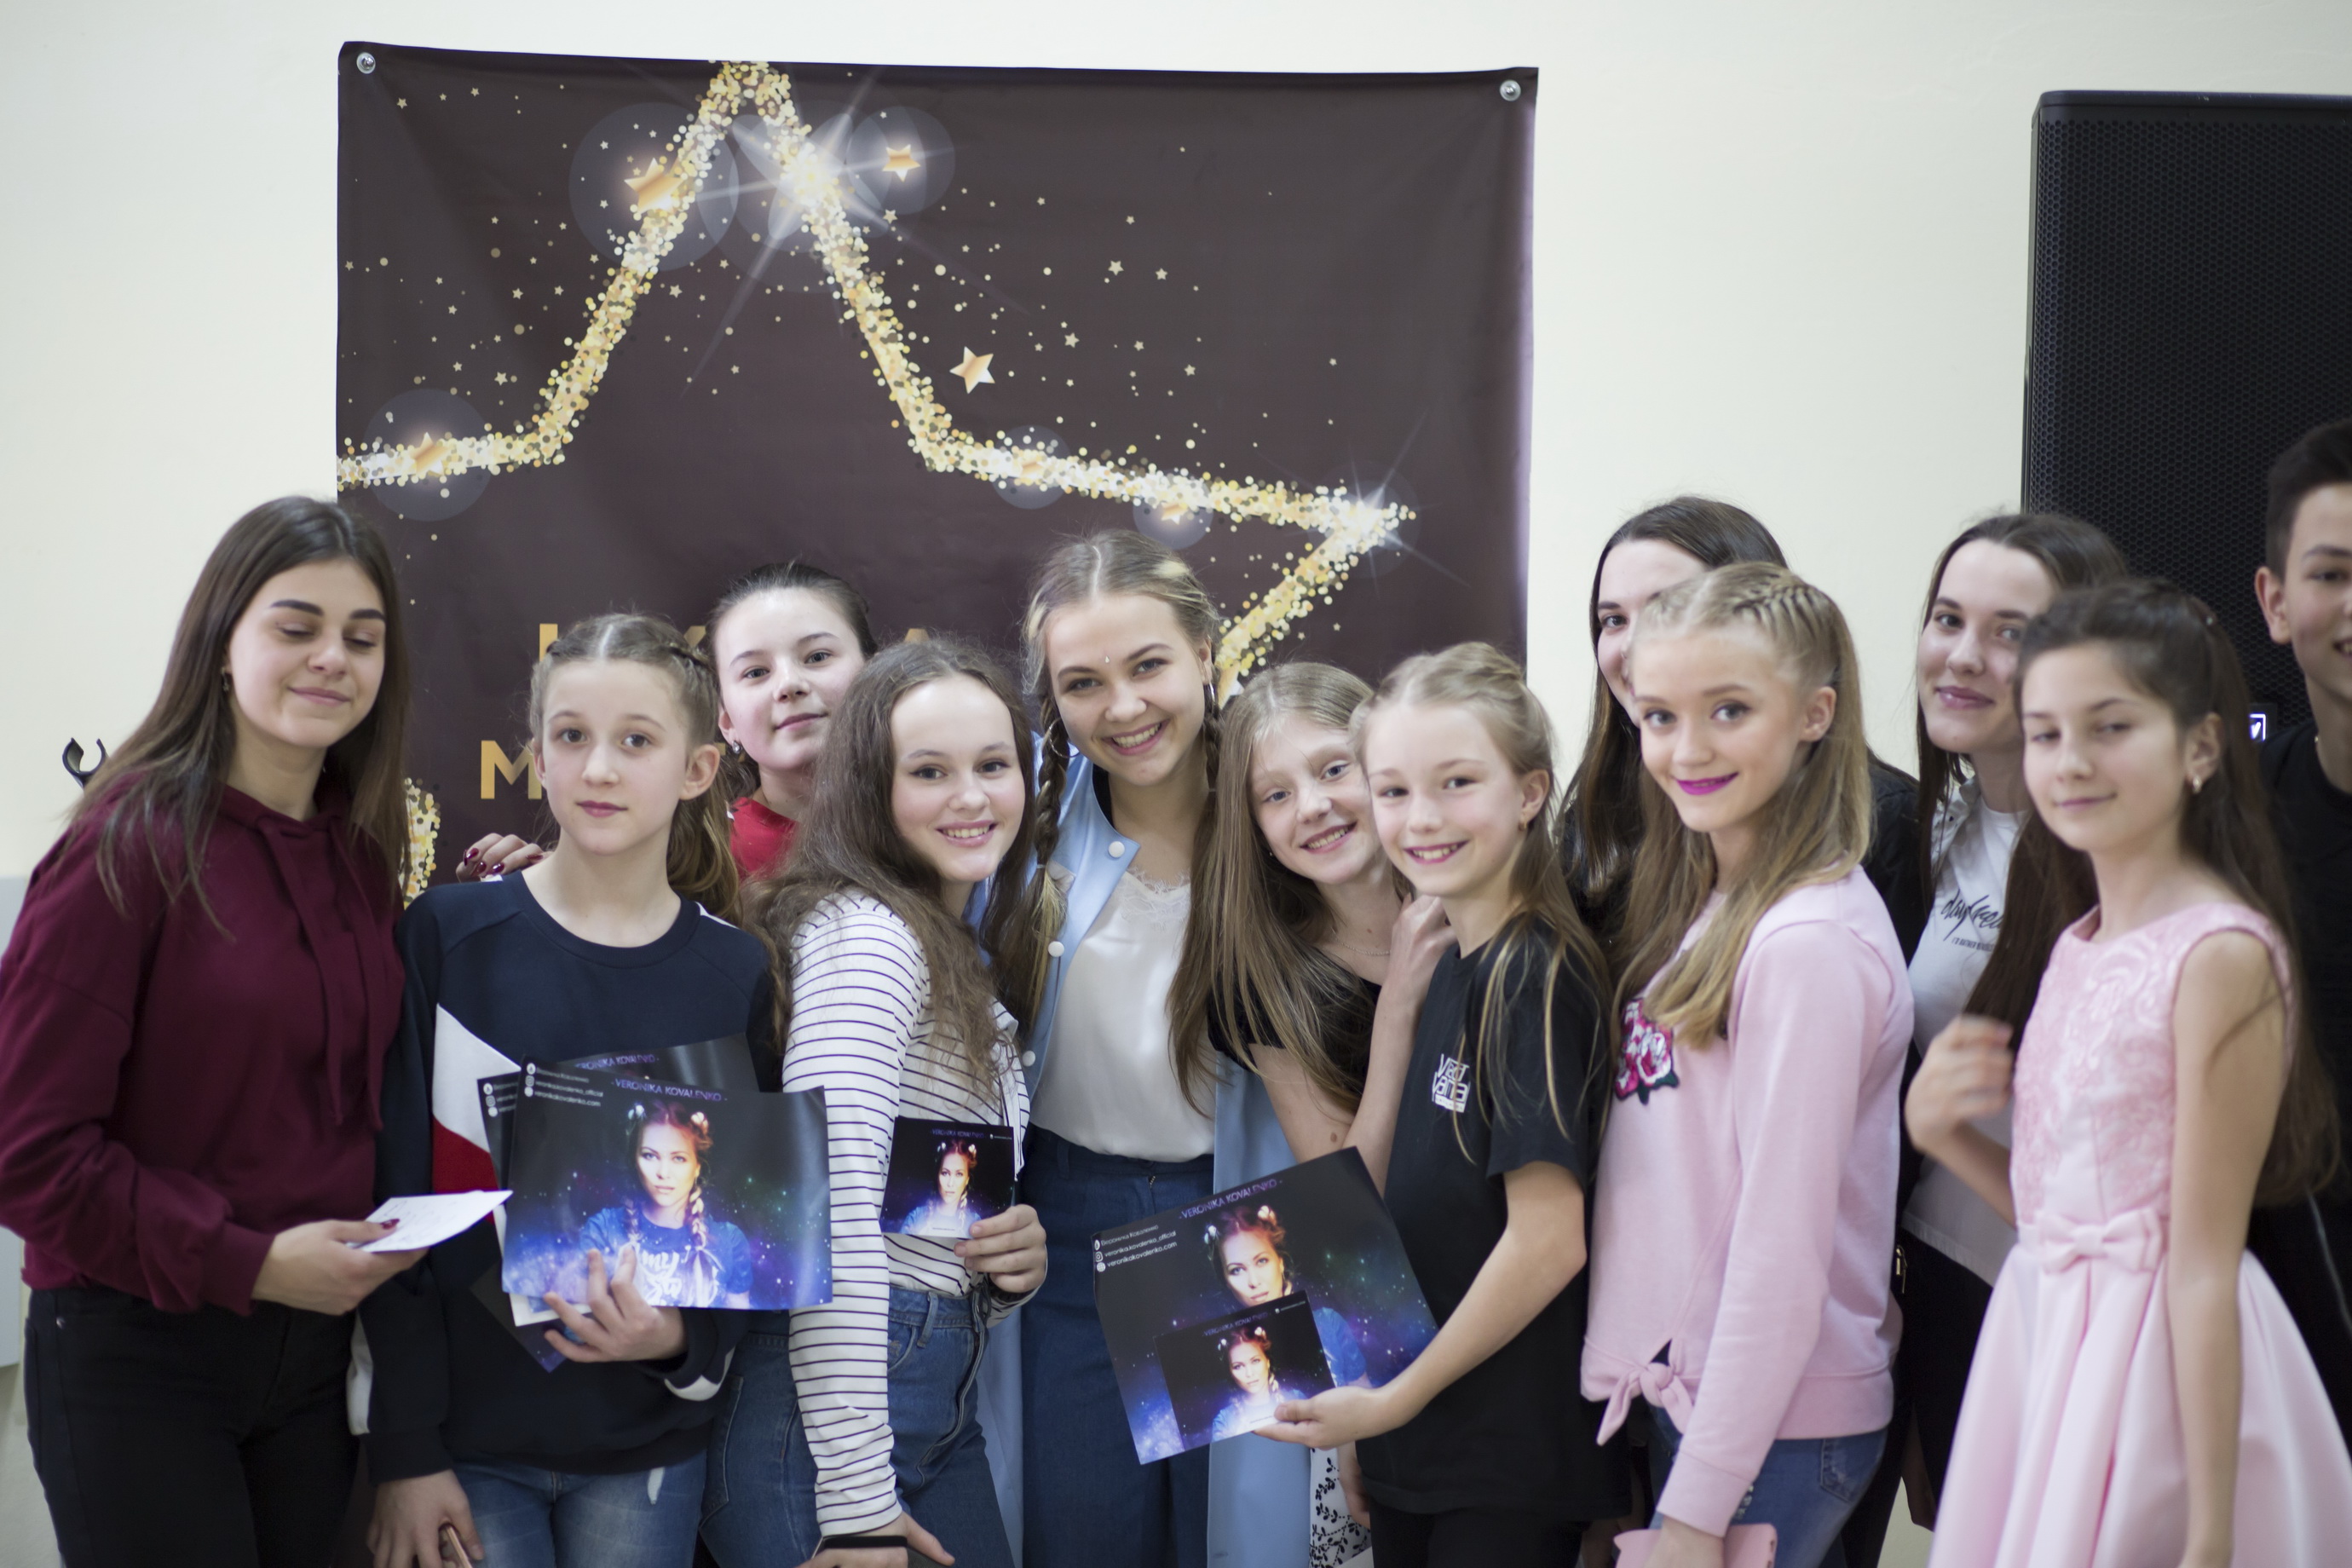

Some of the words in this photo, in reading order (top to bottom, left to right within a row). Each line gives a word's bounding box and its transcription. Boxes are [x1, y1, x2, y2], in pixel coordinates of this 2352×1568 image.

[614, 1078, 663, 1094] VERONIKA
[665, 1087, 722, 1101] KOVALENKO
[1181, 1197, 1225, 1219] VERONIKA
[1225, 1179, 1277, 1203] KOVALENKO
[1107, 1242, 1178, 1267] veronikakovalenko.com
